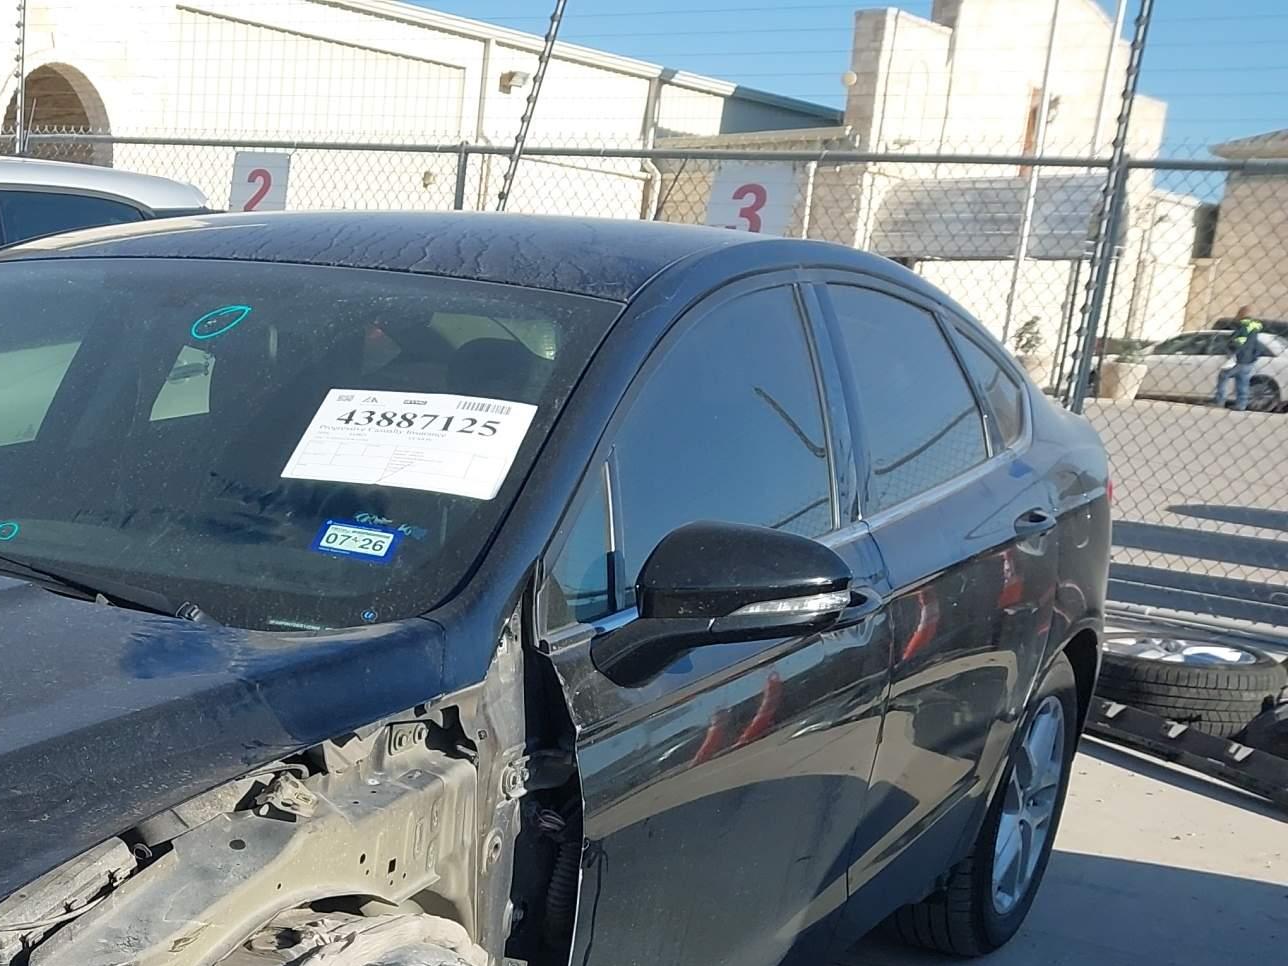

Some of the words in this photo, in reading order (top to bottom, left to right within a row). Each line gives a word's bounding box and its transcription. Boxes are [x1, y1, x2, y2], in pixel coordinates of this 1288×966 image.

[243, 168, 272, 212] 2
[725, 183, 768, 233] 3
[336, 408, 501, 438] 43887125
[325, 532, 352, 546] 07
[359, 537, 386, 553] 26
